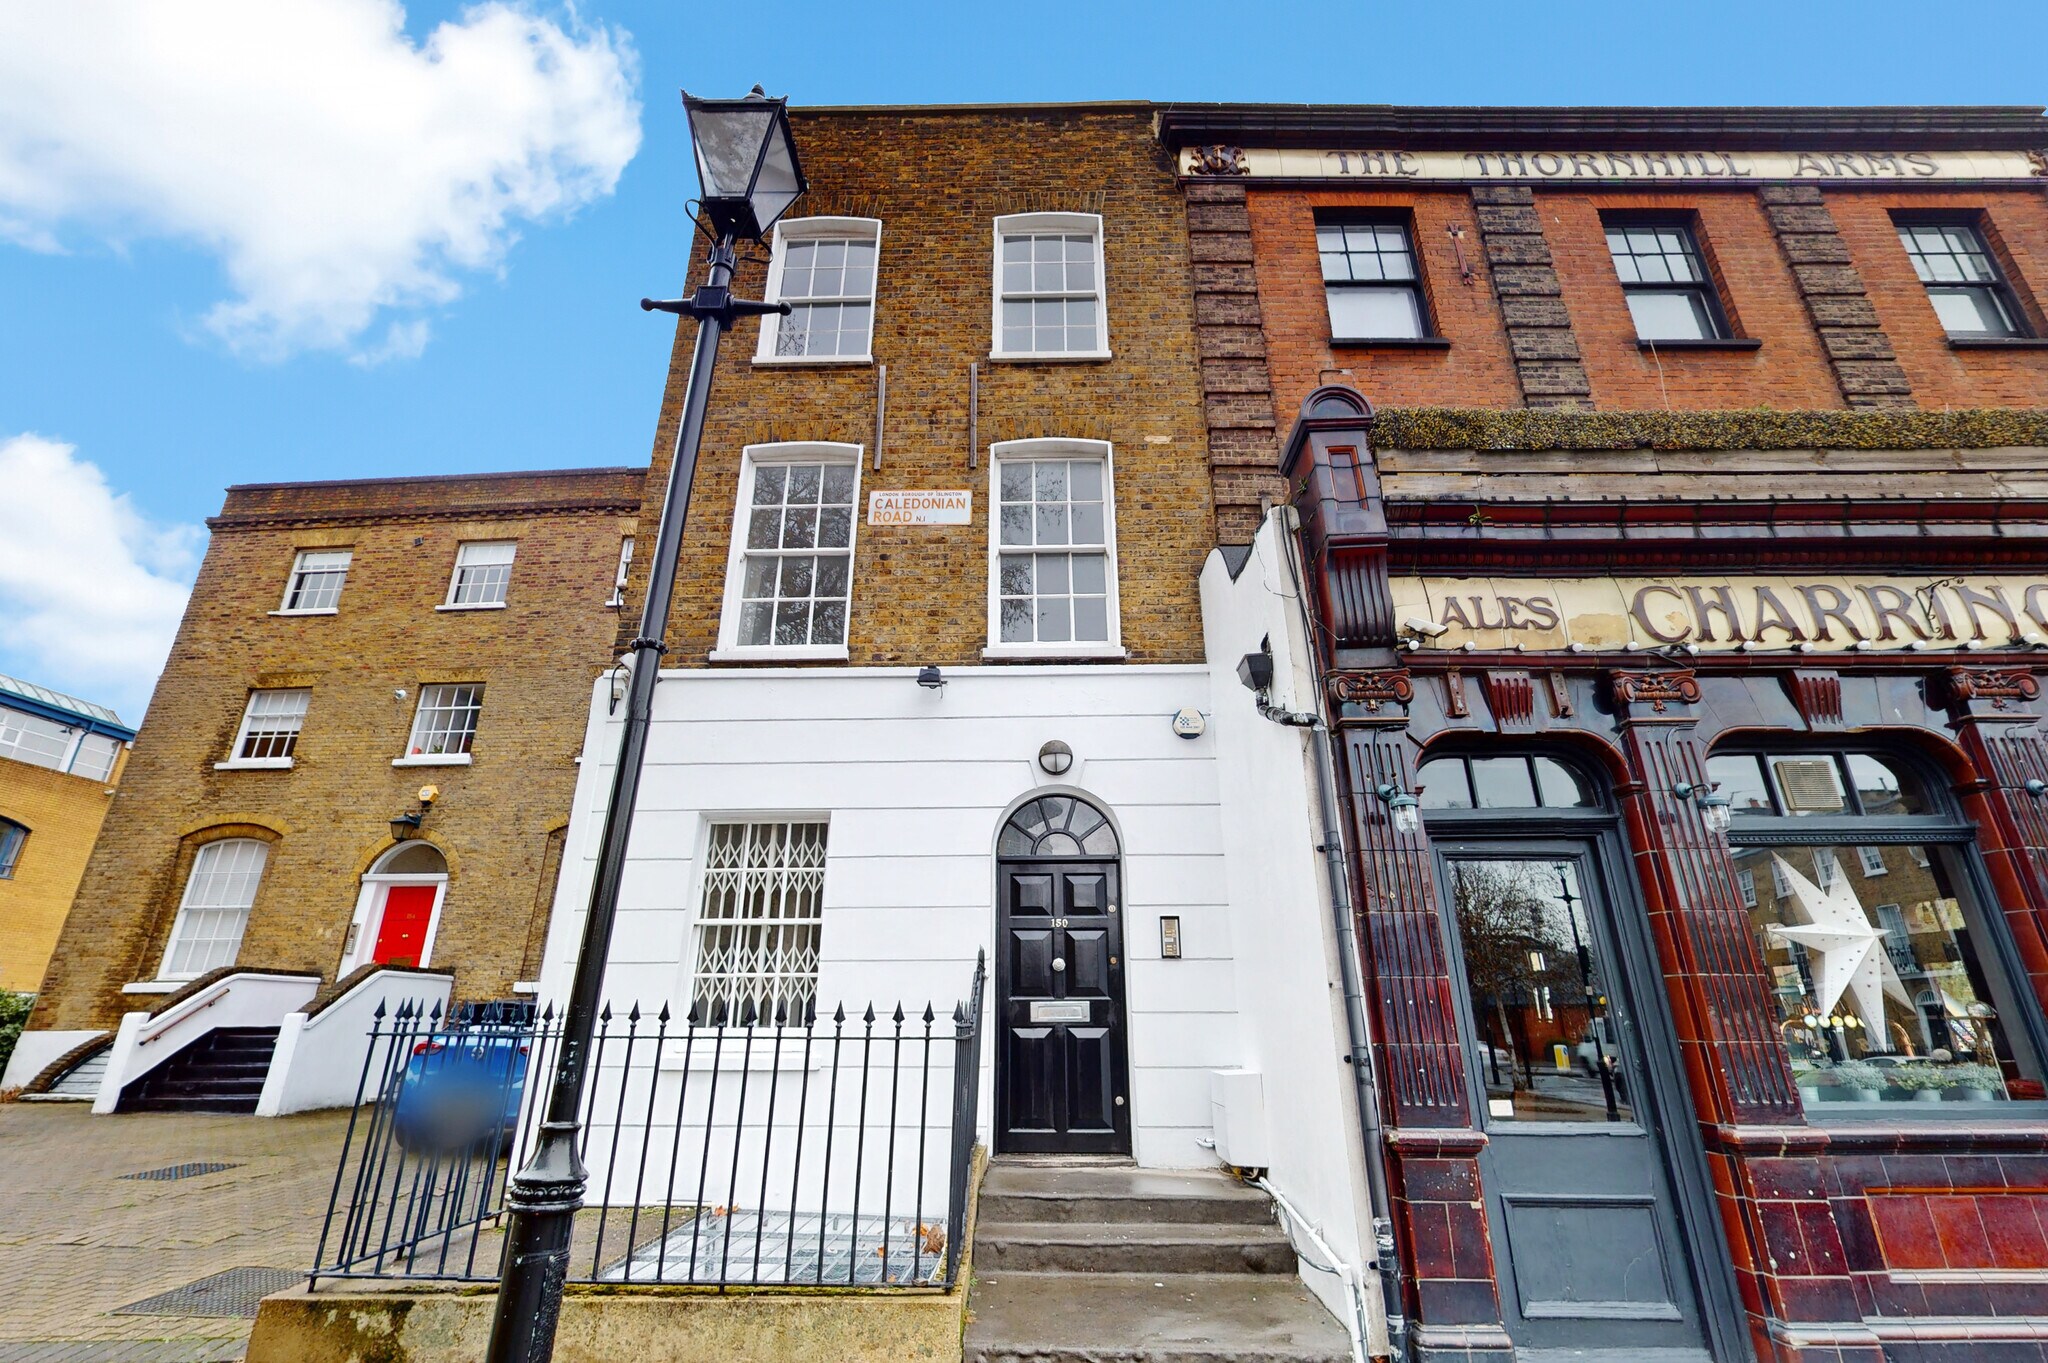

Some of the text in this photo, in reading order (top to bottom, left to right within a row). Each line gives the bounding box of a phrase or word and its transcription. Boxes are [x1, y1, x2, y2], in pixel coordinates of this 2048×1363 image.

[1325, 150, 1941, 176] THE THORNHILL ARMS
[874, 498, 966, 510] CALEDONIAN
[873, 511, 913, 523] ROAD
[1441, 596, 1560, 630] ALES
[1051, 918, 1068, 928] 150
